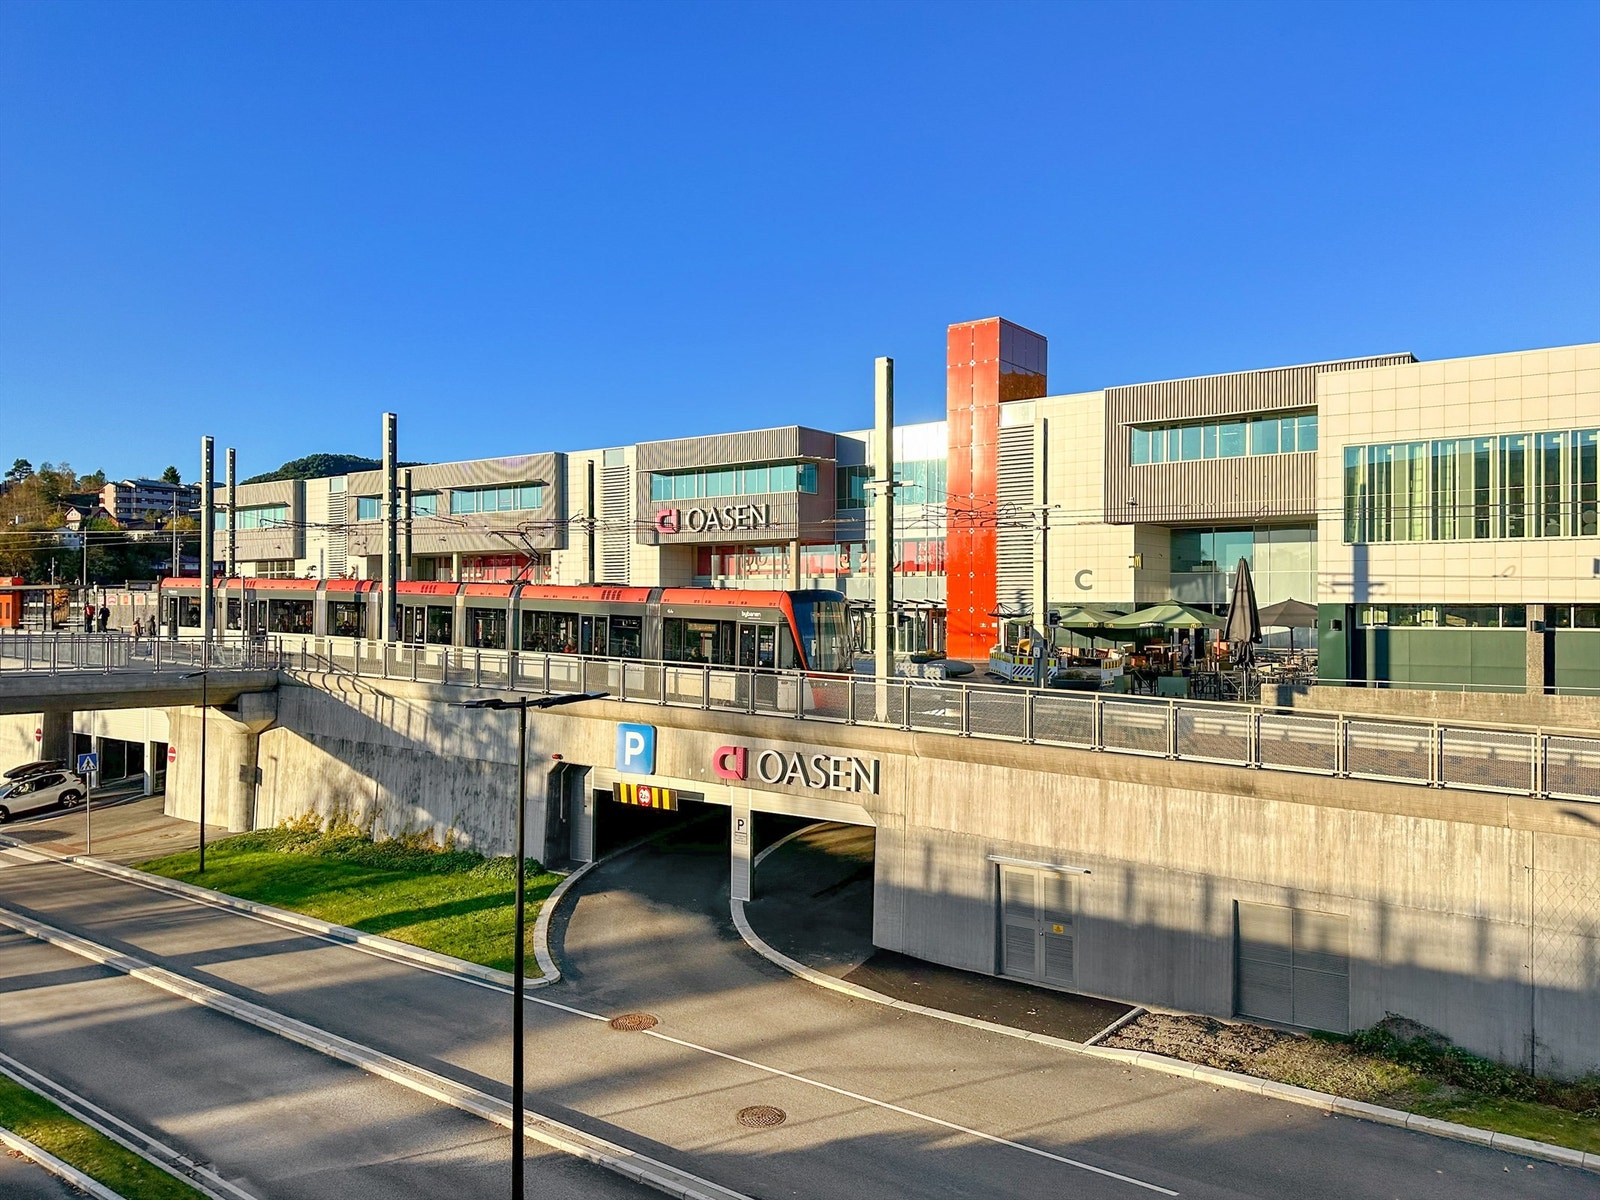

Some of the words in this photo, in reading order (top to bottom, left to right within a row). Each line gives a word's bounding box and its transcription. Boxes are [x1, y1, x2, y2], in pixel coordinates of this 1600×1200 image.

[686, 504, 768, 533] OASEN
[1074, 569, 1093, 590] C
[625, 731, 645, 766] P
[757, 750, 877, 794] OASEN
[737, 819, 744, 831] P
